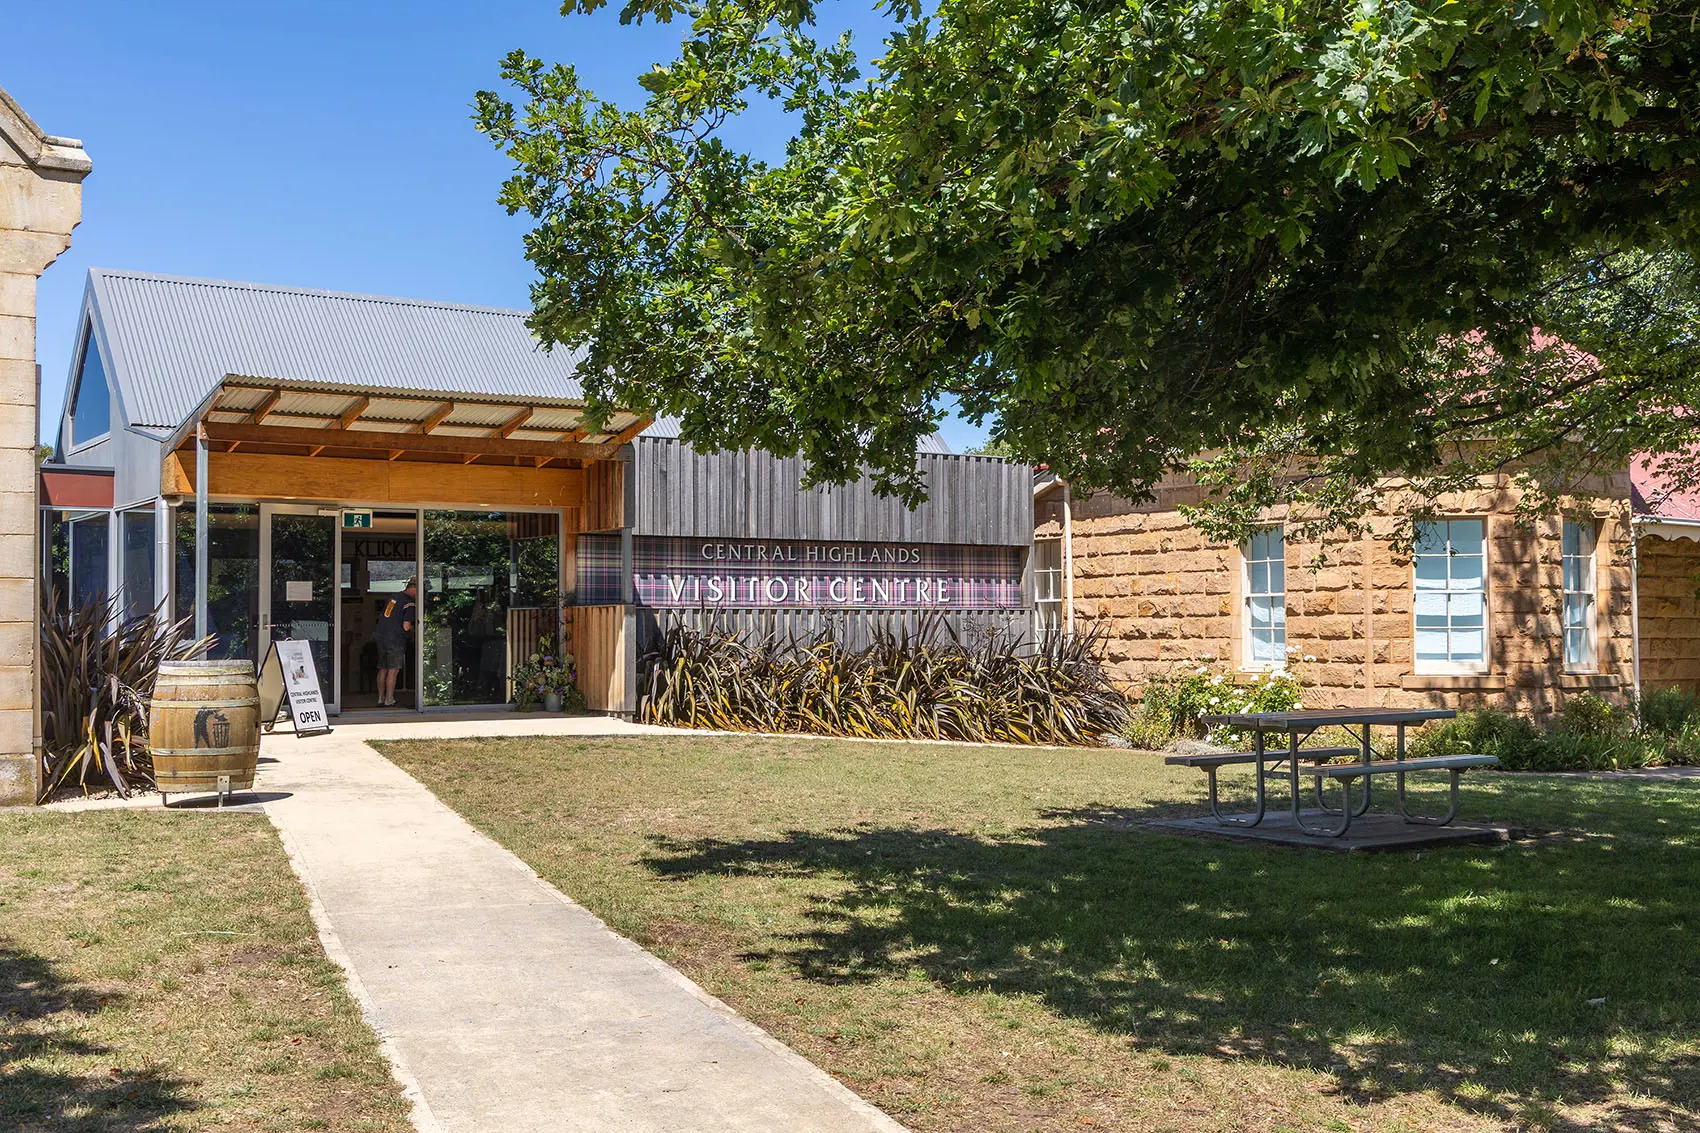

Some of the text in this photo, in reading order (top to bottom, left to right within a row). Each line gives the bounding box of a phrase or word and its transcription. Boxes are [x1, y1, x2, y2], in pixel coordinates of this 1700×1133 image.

[701, 543, 921, 563] CENTRAL HIGHLANDS
[667, 575, 951, 603] VISITOR CENTRE
[300, 711, 321, 723] OPEN
